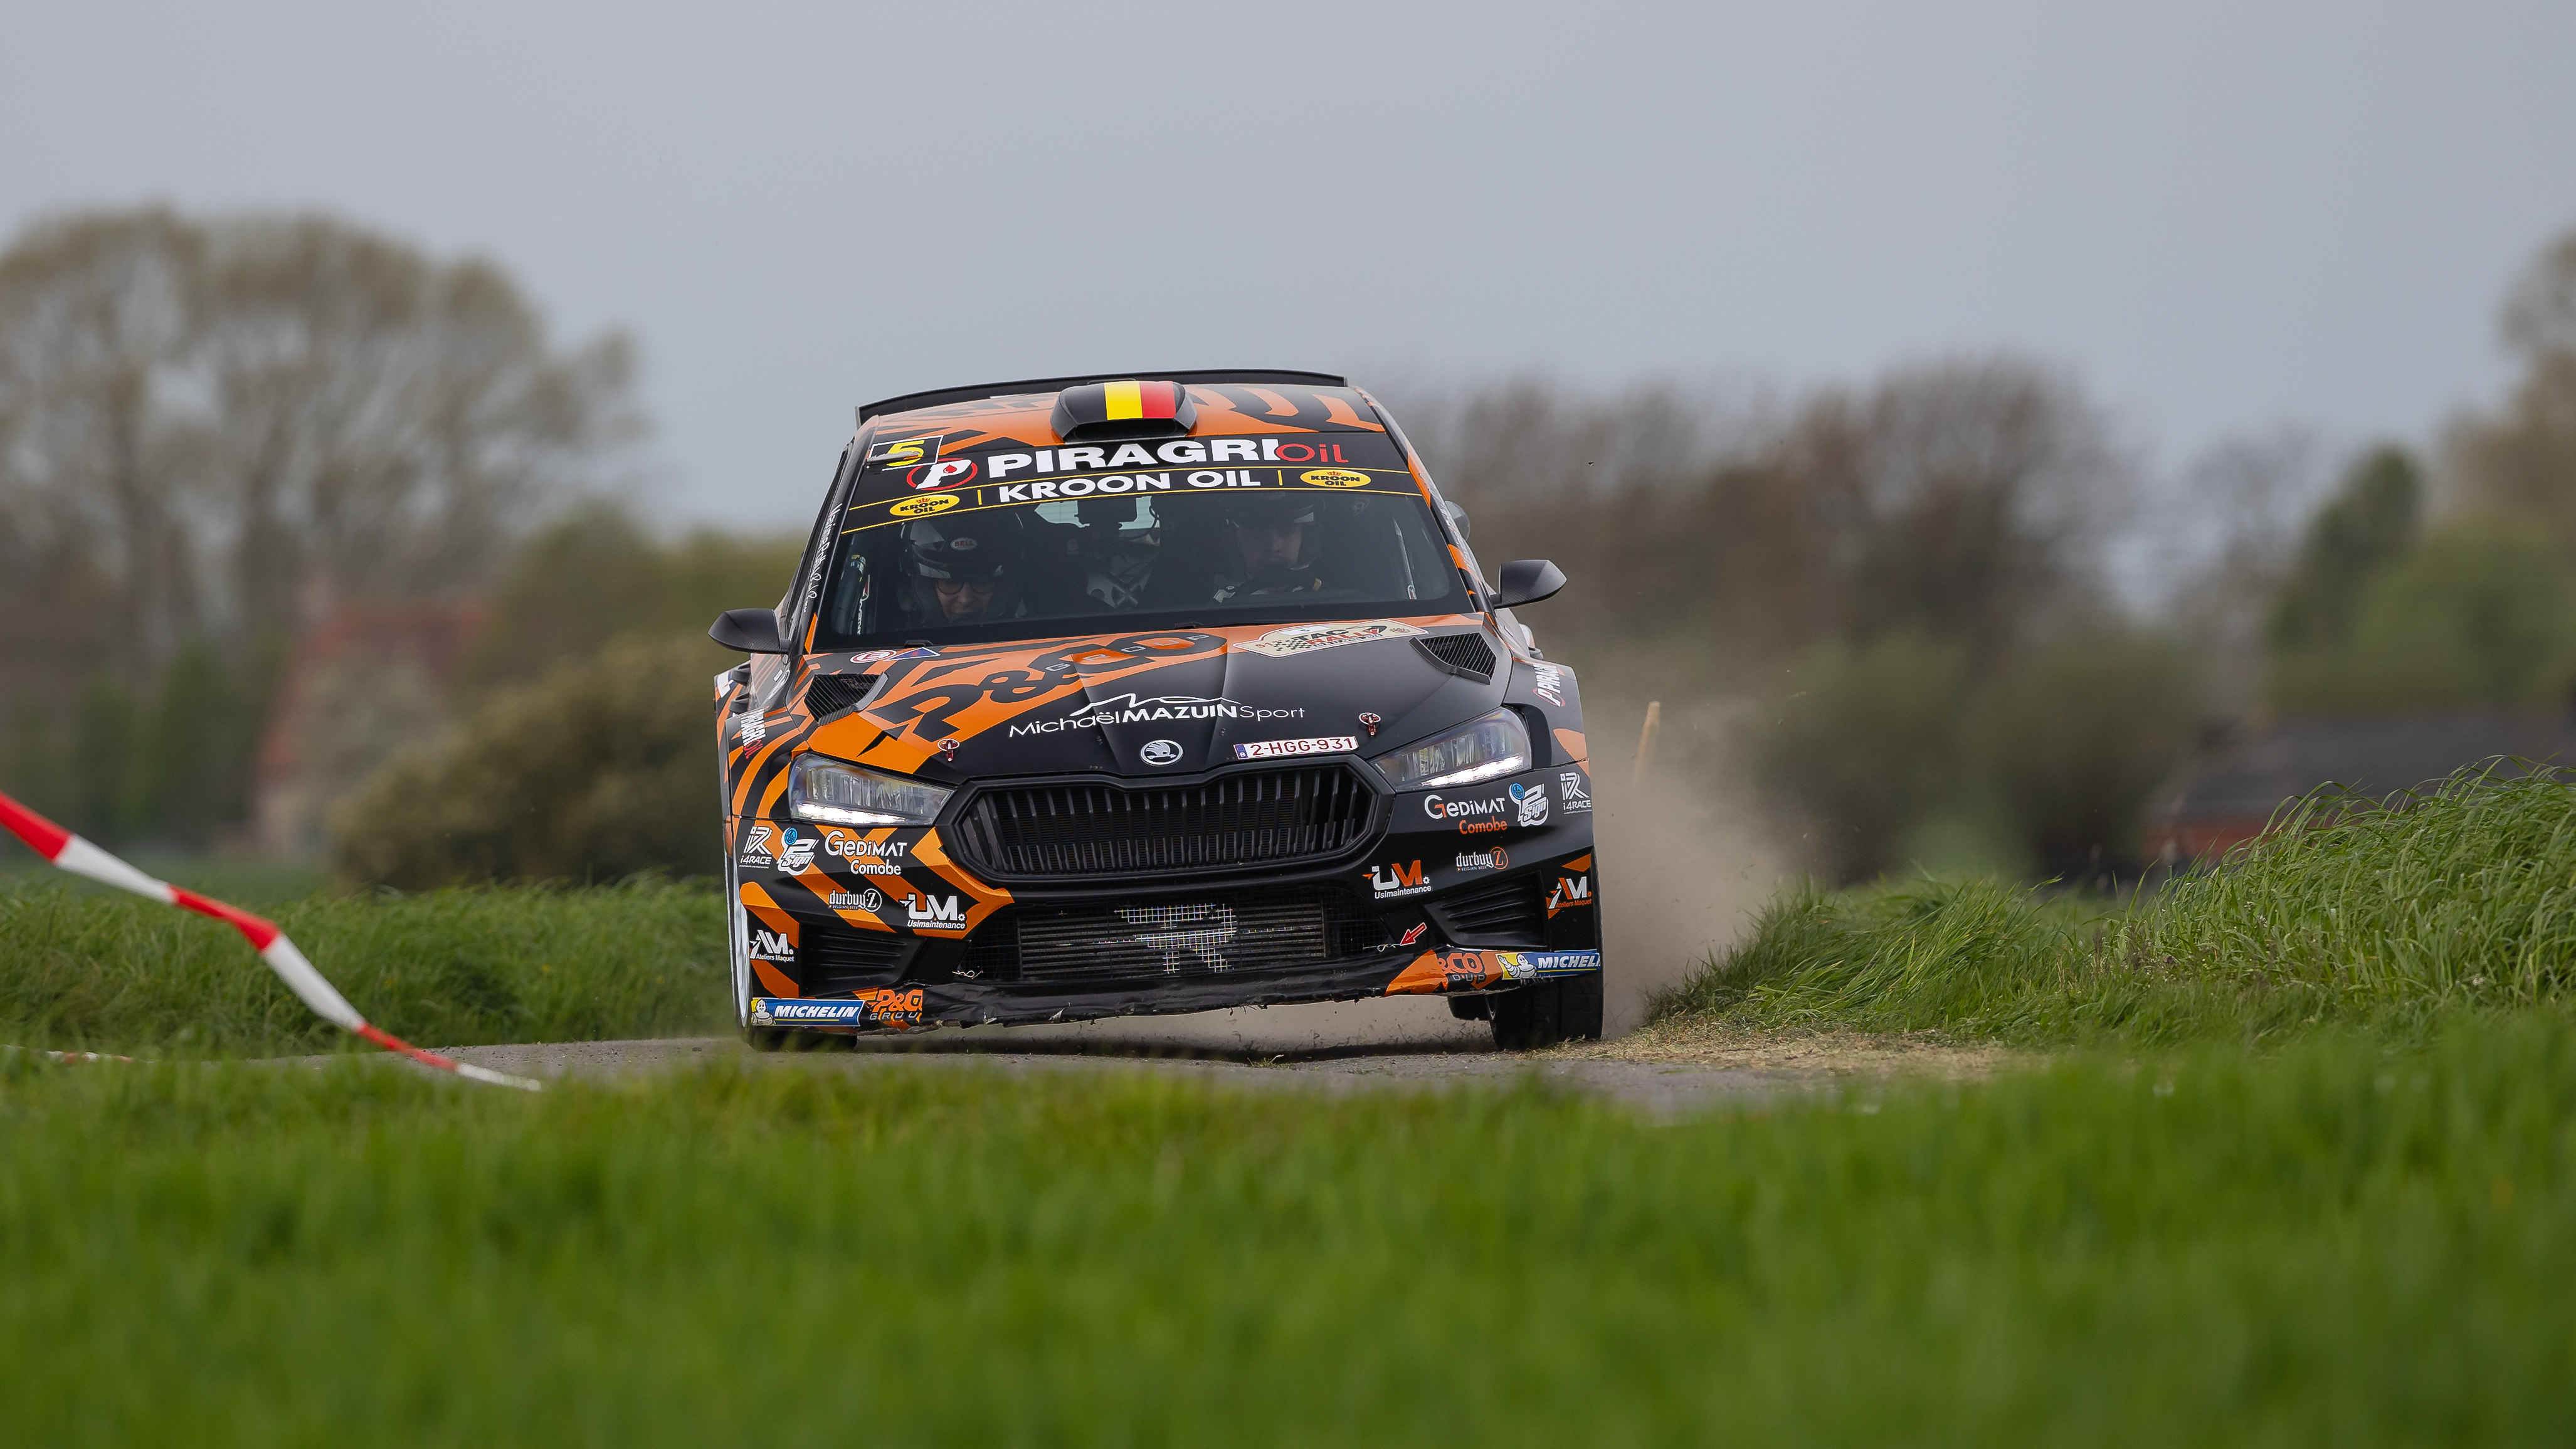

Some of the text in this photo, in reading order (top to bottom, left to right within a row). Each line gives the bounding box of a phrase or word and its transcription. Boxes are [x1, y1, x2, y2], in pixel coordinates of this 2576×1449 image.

[887, 440, 925, 466] 5
[988, 439, 1280, 478] PIRAGRI
[999, 470, 1260, 502] KROON OIL
[900, 499, 949, 512] KROON
[1294, 630, 1349, 641] TAC
[1306, 629, 1380, 645] RALLY
[1045, 634, 1210, 672] GROUP
[1250, 737, 1355, 756] 2-HGG-931
[1563, 800, 1592, 810] i4RACE
[1459, 816, 1507, 834] Comobe
[741, 855, 772, 865] i4RACE
[851, 859, 902, 875] Comobe
[1456, 851, 1494, 868] durbuy
[829, 890, 866, 909] durbuy
[1375, 886, 1431, 899] Usimaintenance
[907, 920, 965, 929] Usimaintenance
[1538, 955, 1601, 969] MICHELI
[774, 1005, 859, 1018] MICHELIN
[870, 1012, 919, 1021] GROU
